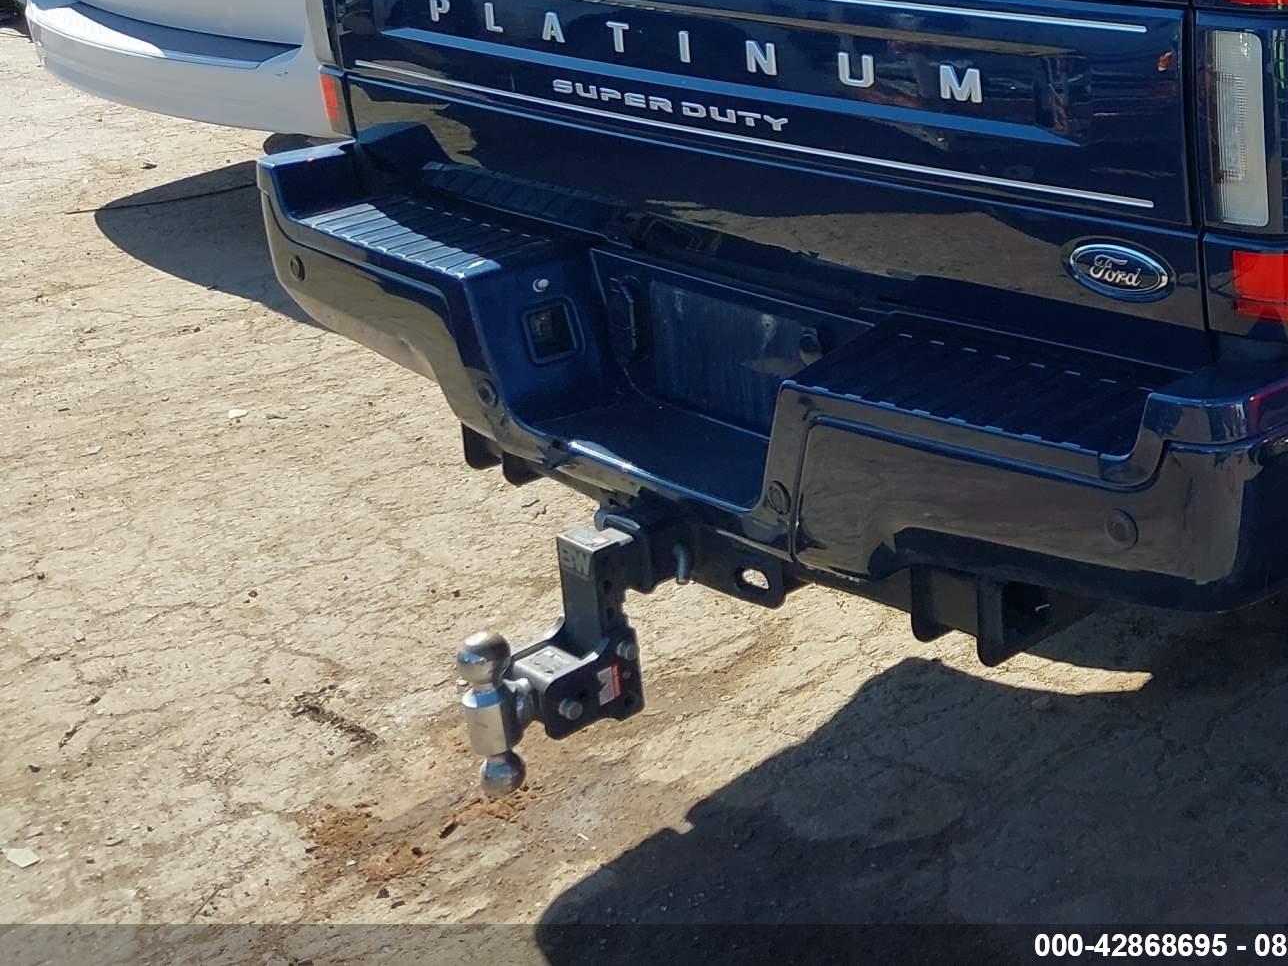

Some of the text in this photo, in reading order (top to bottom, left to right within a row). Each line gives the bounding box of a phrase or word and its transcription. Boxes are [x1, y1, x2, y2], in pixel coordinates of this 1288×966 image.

[553, 79, 788, 131] SUPER DUTY
[1090, 254, 1141, 286] Ford
